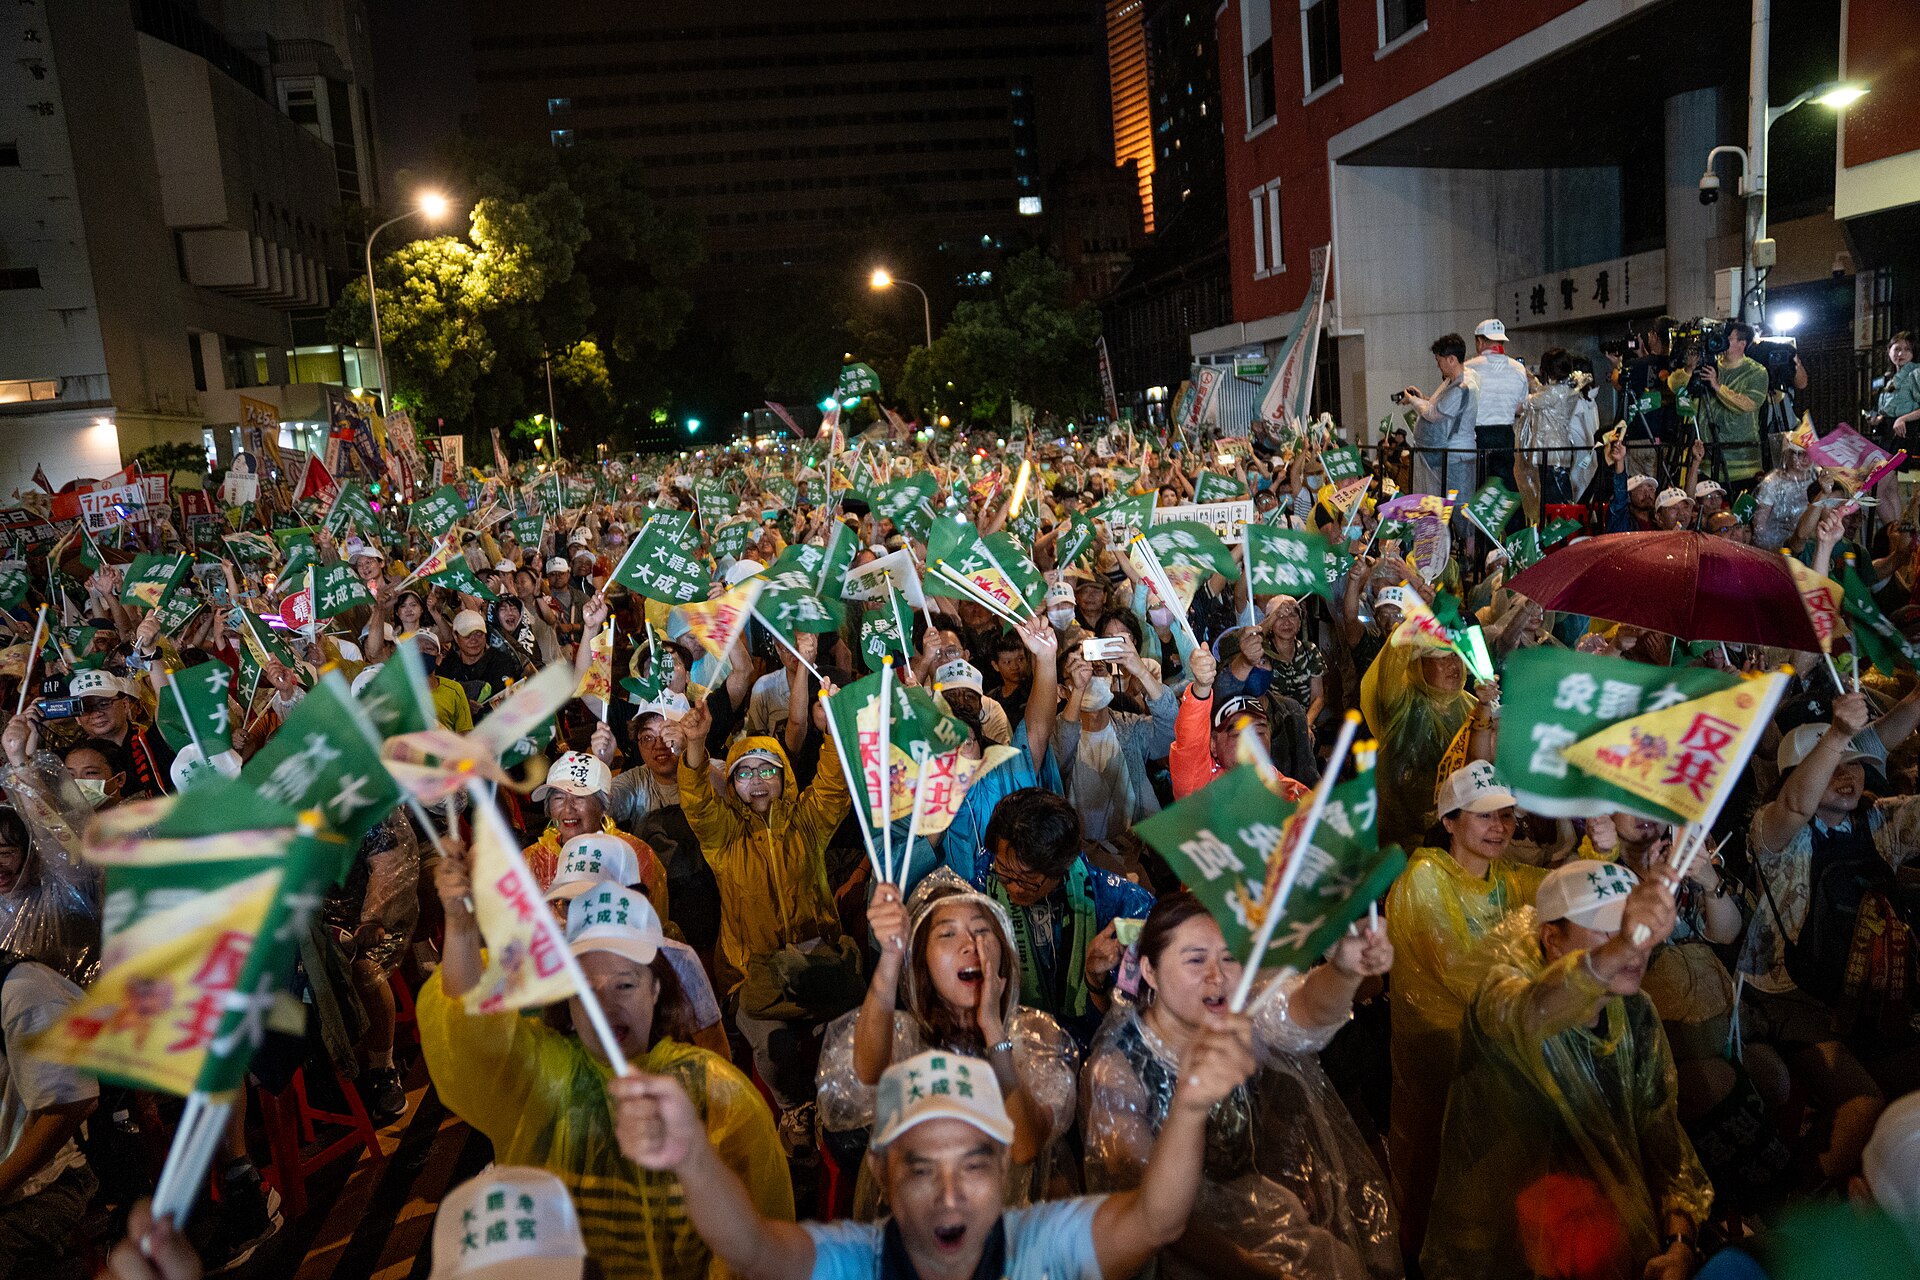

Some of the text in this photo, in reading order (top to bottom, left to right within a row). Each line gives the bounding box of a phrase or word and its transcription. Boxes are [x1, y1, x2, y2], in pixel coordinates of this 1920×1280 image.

[418, 496, 449, 516] 大罷免
[424, 504, 460, 533] 大成宮
[651, 545, 701, 578] 大罷免
[324, 566, 360, 587] 大罷免
[631, 563, 699, 601] 大成宮
[321, 582, 367, 610] 大成宮
[43, 681, 59, 693] GAP
[1662, 713, 1742, 802] 反共
[565, 860, 601, 874] 大成宮
[582, 892, 630, 910] 大罷免
[583, 910, 629, 926] 大成宮
